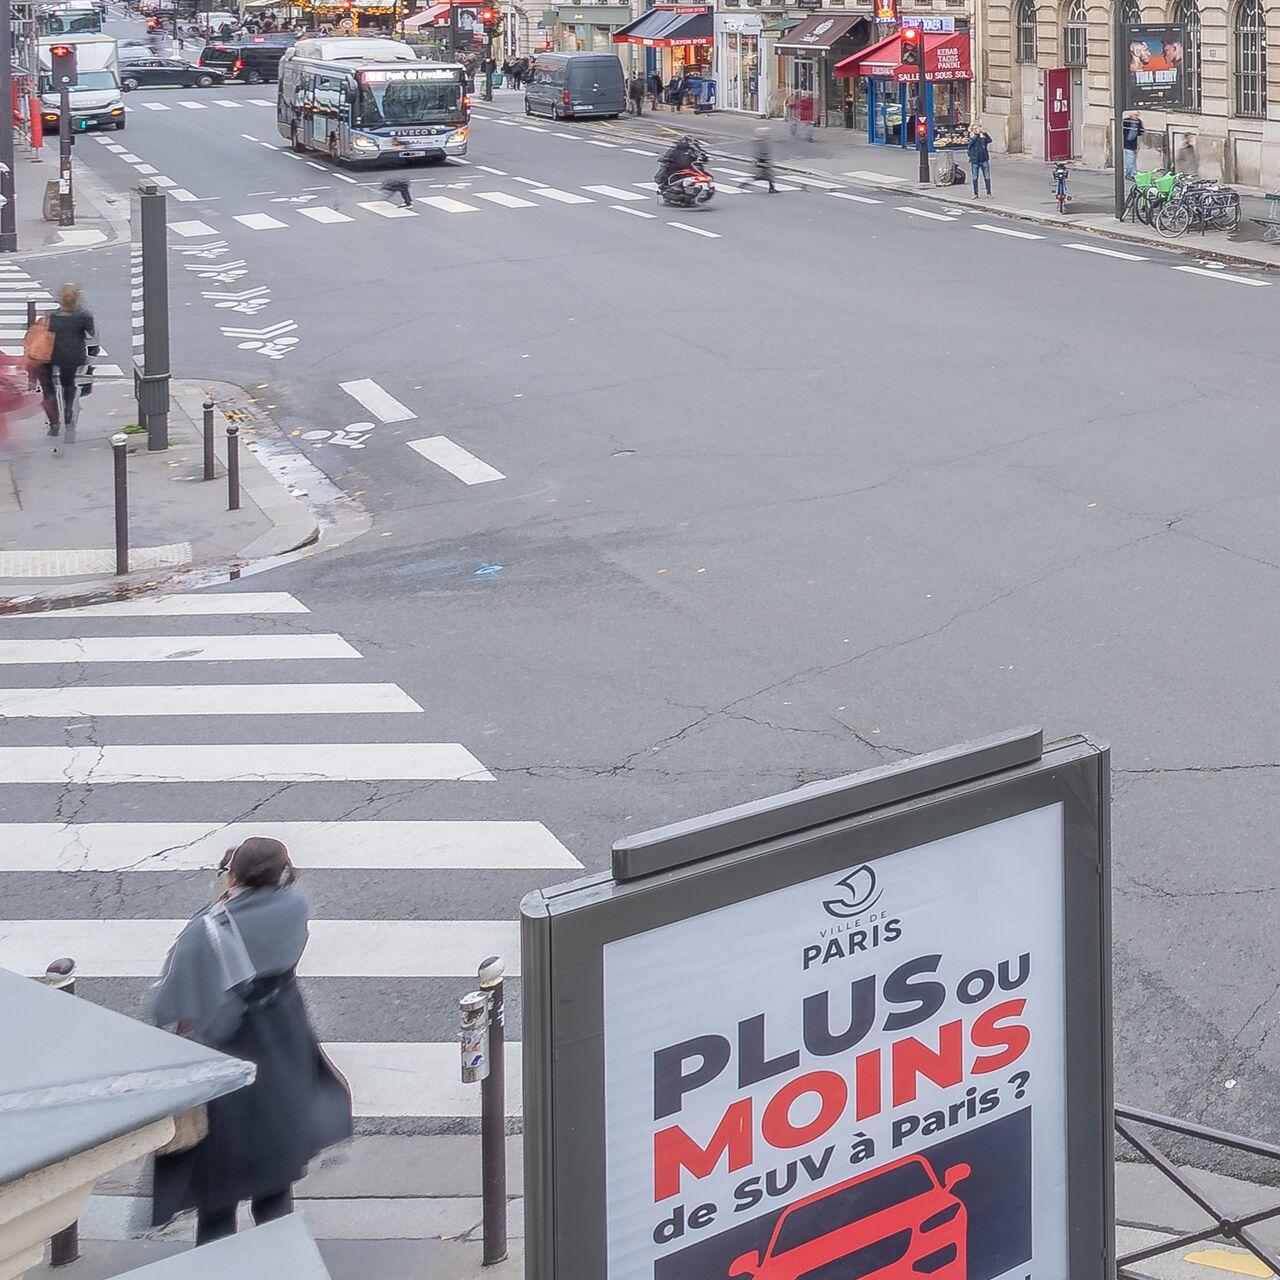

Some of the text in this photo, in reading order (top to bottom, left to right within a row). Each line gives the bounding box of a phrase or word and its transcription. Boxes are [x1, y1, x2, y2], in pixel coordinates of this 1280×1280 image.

[937, 47, 958, 55] KEBAB
[937, 61, 960, 69] PANINI
[898, 73, 920, 81] SALLE
[935, 71, 953, 79] SOUS
[955, 70, 968, 78] SOL
[819, 910, 888, 939] VILLE DE
[803, 919, 903, 971] PARIS
[653, 953, 947, 1122] PLUS
[653, 998, 1031, 1203] MOINS
[653, 1070, 1031, 1244] de SUV à Paris ?
